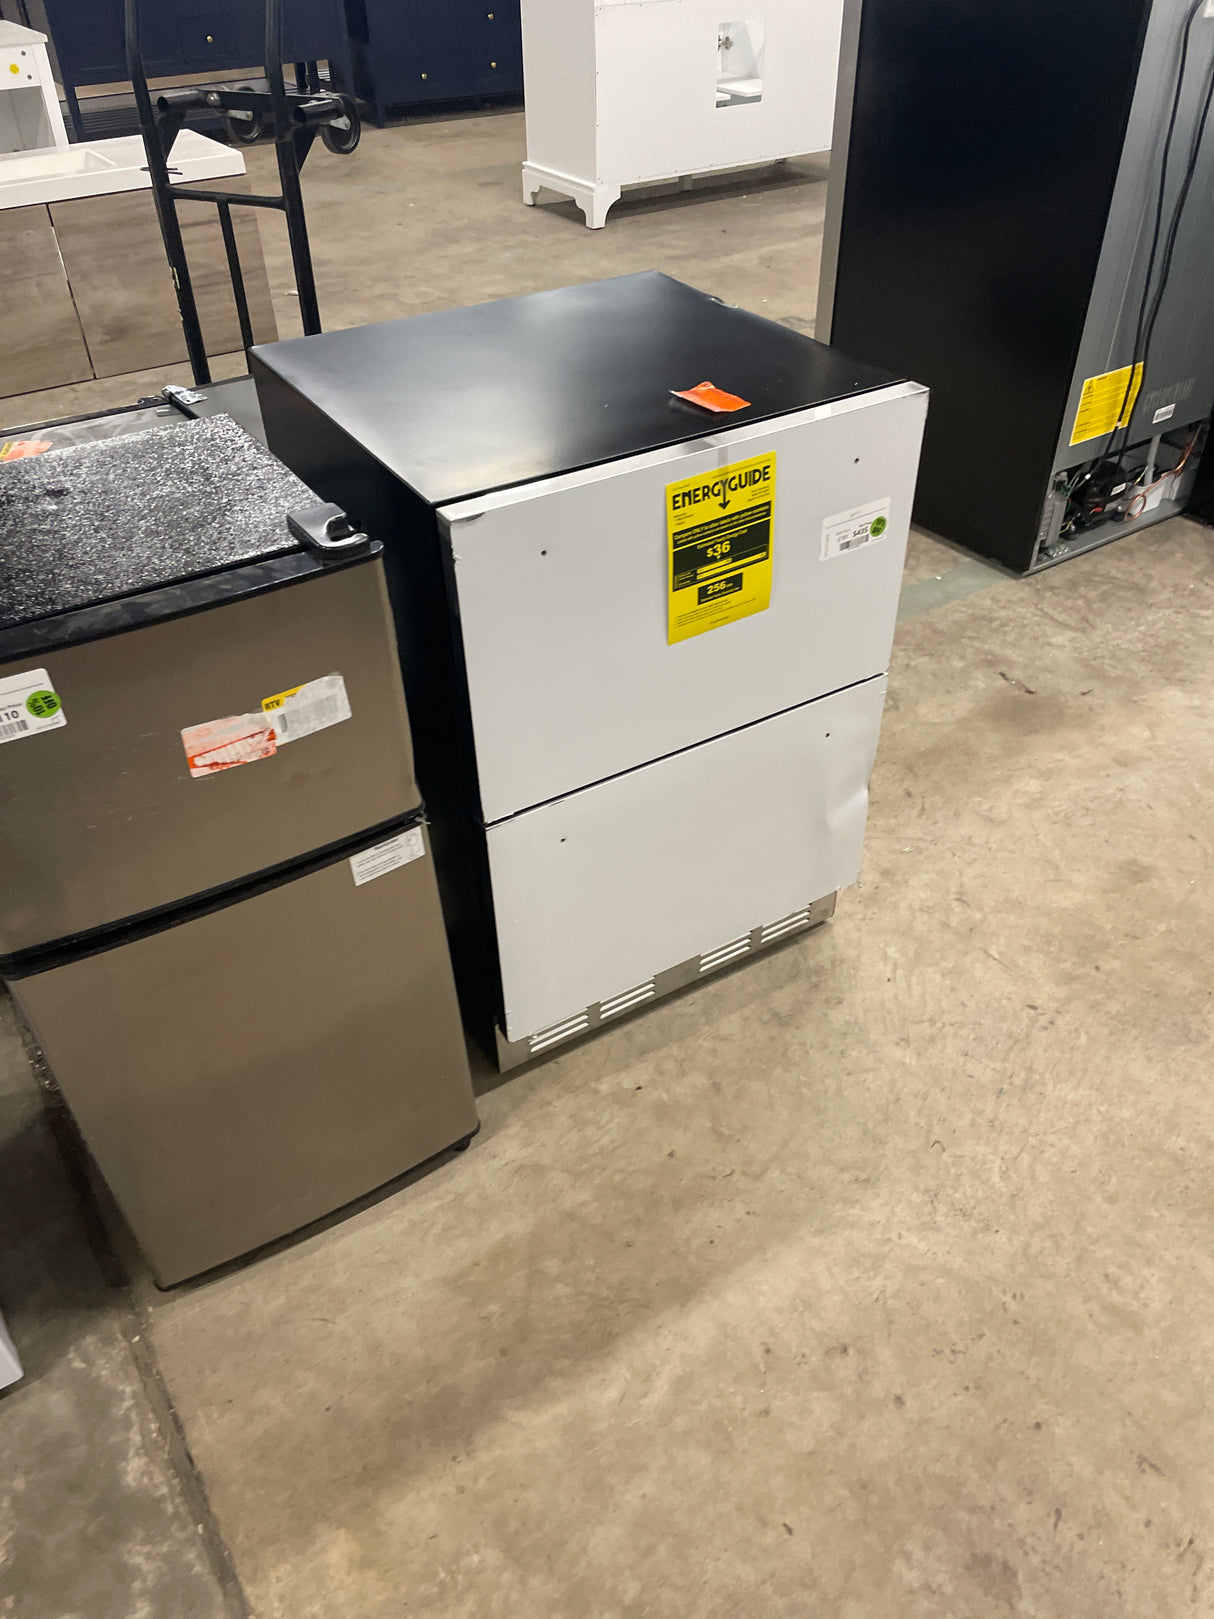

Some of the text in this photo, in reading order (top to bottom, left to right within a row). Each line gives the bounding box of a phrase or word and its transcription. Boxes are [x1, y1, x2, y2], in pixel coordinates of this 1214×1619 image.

[672, 465, 771, 510] ENERGYGUIDE
[706, 541, 731, 557] $36
[706, 581, 726, 594] 256
[41, 695, 58, 709] OFF
[264, 699, 280, 710] RTV
